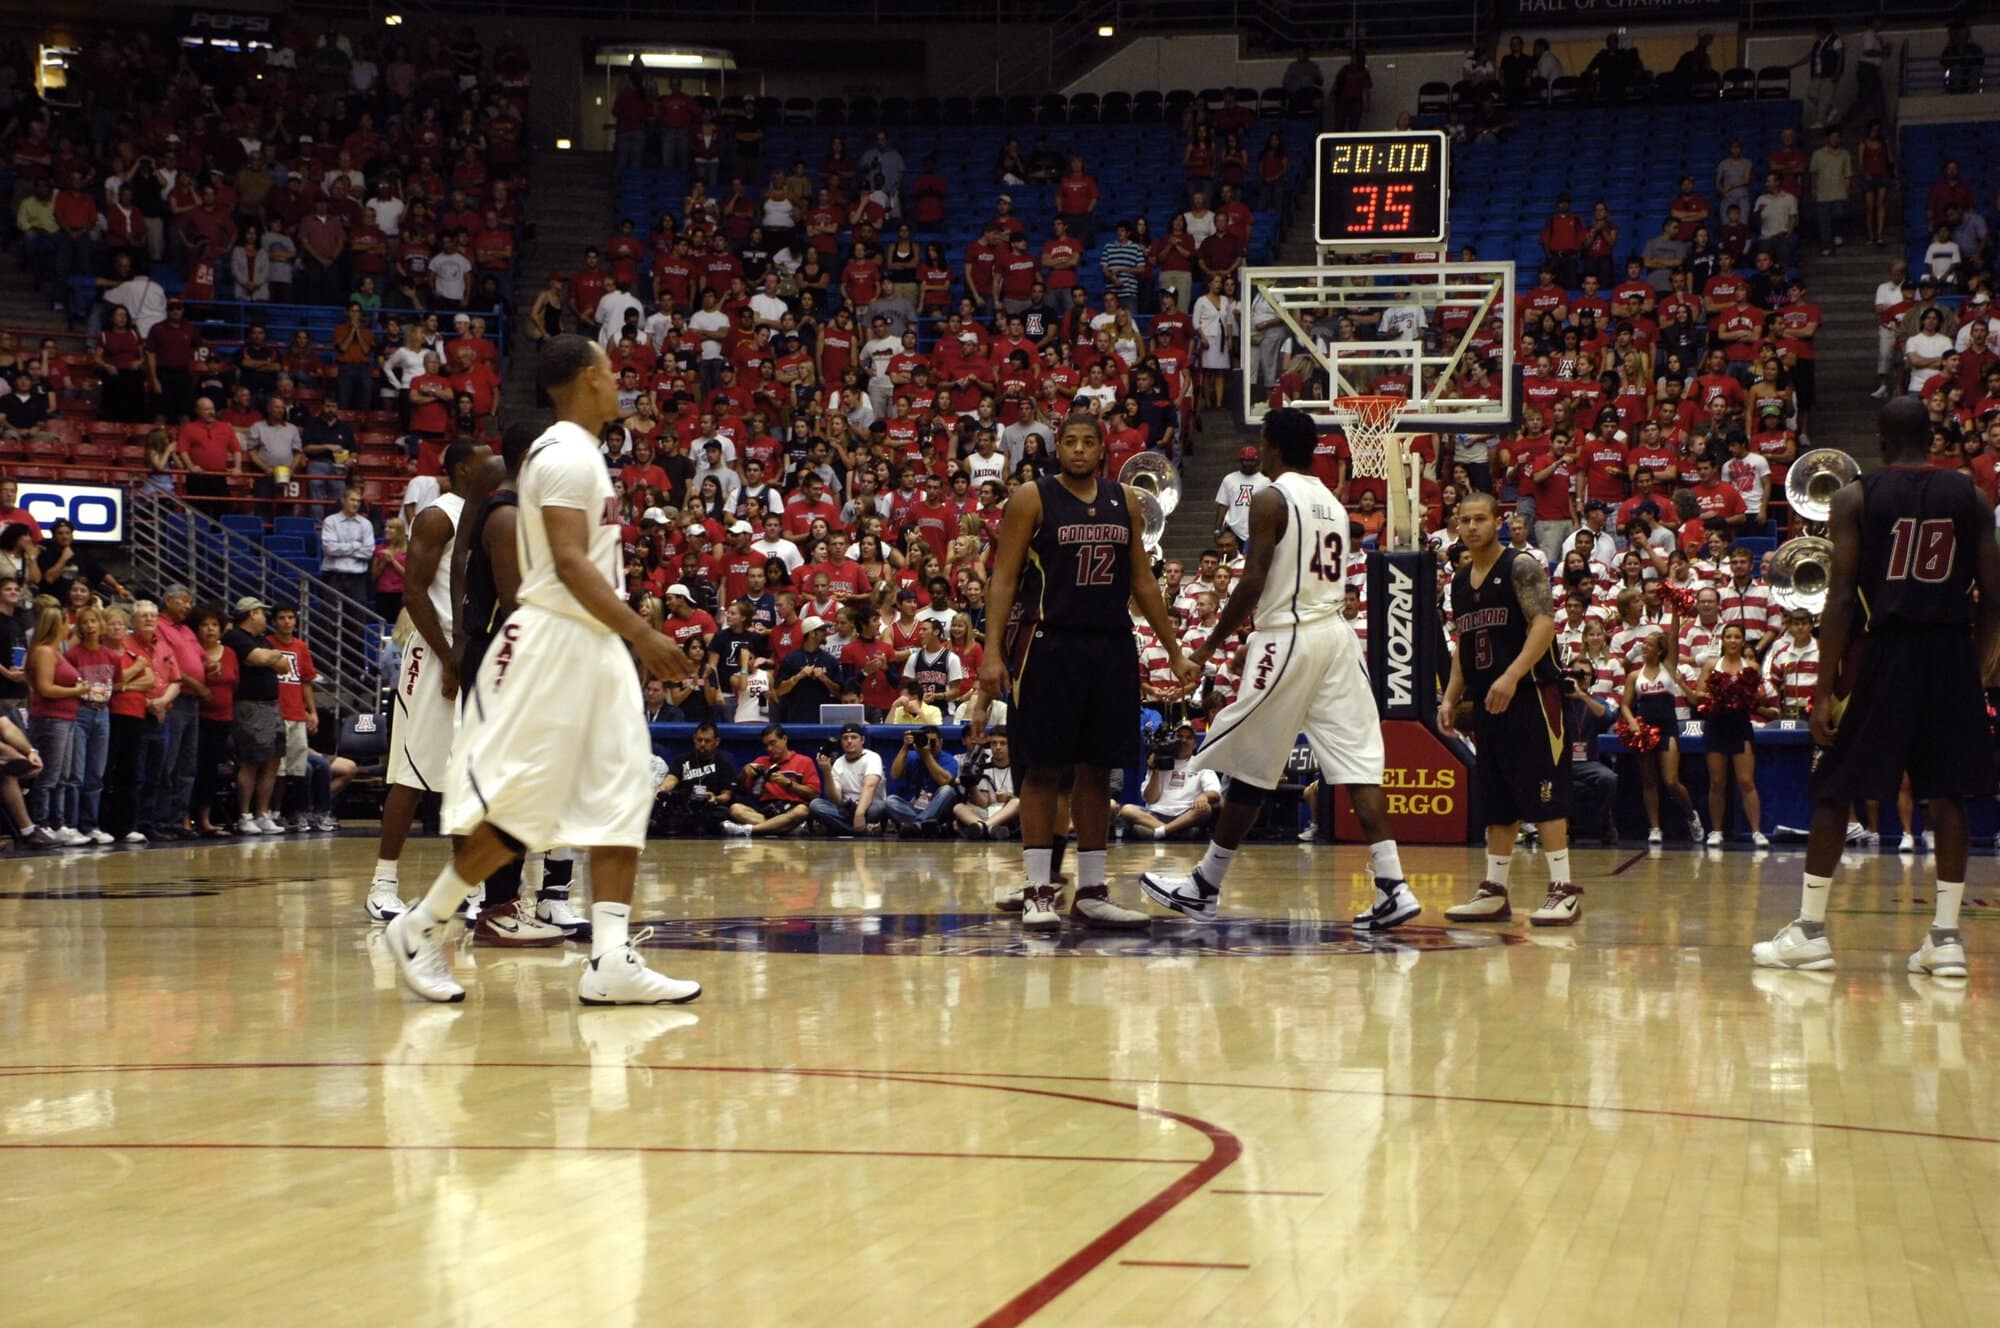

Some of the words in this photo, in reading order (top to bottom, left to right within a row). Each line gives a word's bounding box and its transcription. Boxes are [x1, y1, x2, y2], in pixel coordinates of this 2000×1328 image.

[191, 12, 271, 31] PEPSI
[1519, 0, 1566, 12] HALL
[1332, 143, 1429, 173] 20:00
[1347, 185, 1414, 232] 35
[1075, 545, 1117, 586] 12
[1310, 530, 1342, 583] 43
[1887, 518, 1957, 583] 10
[1387, 563, 1413, 707] ARIZONA
[1475, 629, 1493, 669] 9
[407, 647, 423, 696] CATS
[1253, 642, 1276, 690] CATS
[1381, 768, 1456, 789] ELLS
[1386, 794, 1455, 815] RGO
